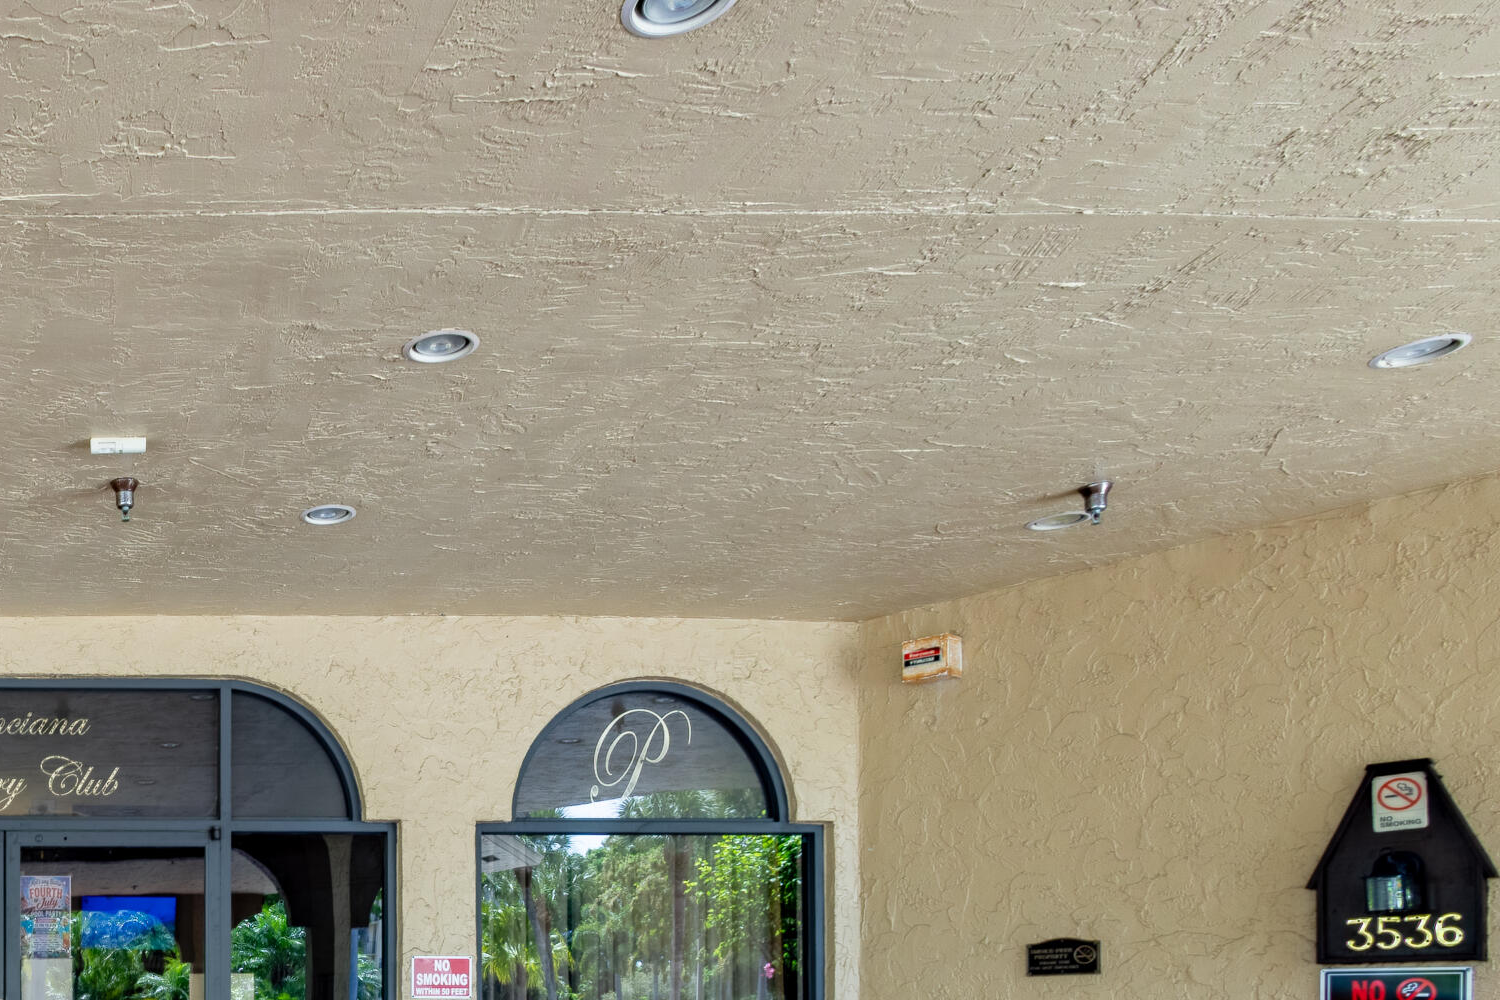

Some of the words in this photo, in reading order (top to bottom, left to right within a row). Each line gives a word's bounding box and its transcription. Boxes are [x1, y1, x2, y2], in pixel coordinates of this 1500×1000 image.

[589, 708, 693, 802] P
[40, 755, 120, 796] Club
[1380, 818, 1422, 828] SMOKING
[29, 887, 63, 899] FOURTH
[36, 897, 59, 909] July
[1346, 912, 1465, 952] 3536
[434, 960, 451, 972] NO
[416, 973, 468, 986] SMOKING
[416, 987, 441, 995] WITHIN
[442, 987, 450, 995] 50
[451, 987, 468, 995] FEET
